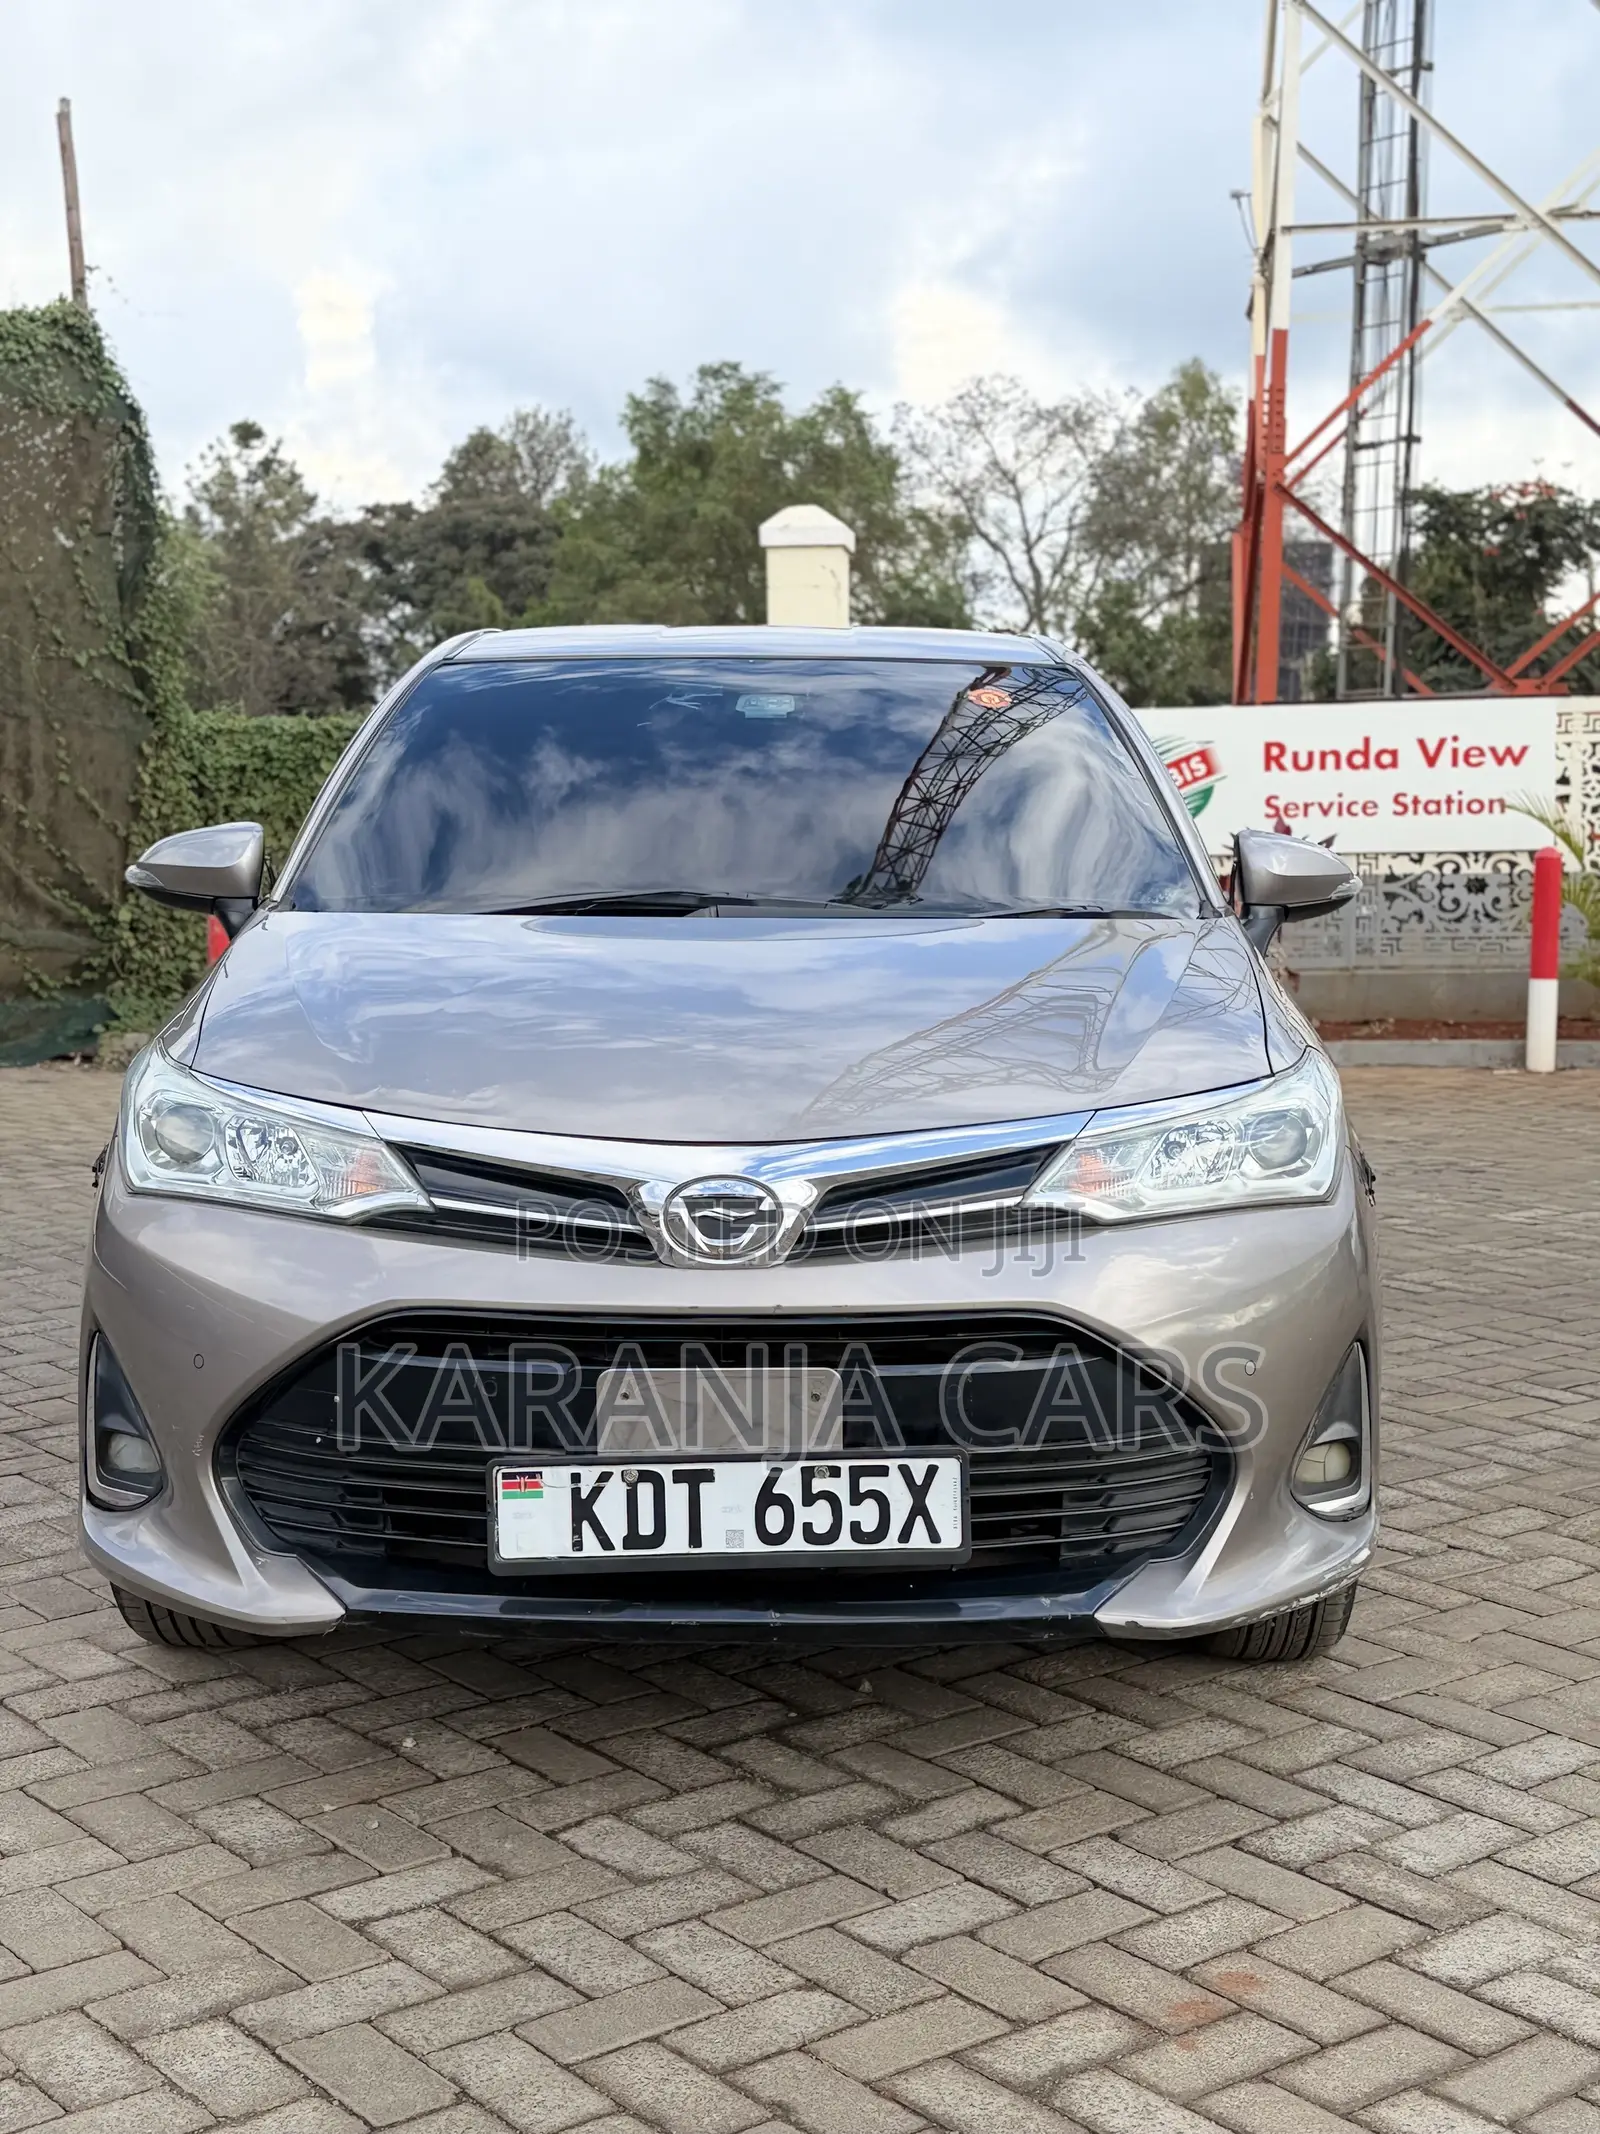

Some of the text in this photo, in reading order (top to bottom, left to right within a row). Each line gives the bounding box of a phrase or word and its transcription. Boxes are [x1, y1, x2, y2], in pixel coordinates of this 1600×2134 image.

[1263, 734, 1531, 773] Runda View
[1263, 789, 1508, 820] Service Station
[571, 1468, 717, 1552] KDT
[754, 1463, 943, 1547] 655X
